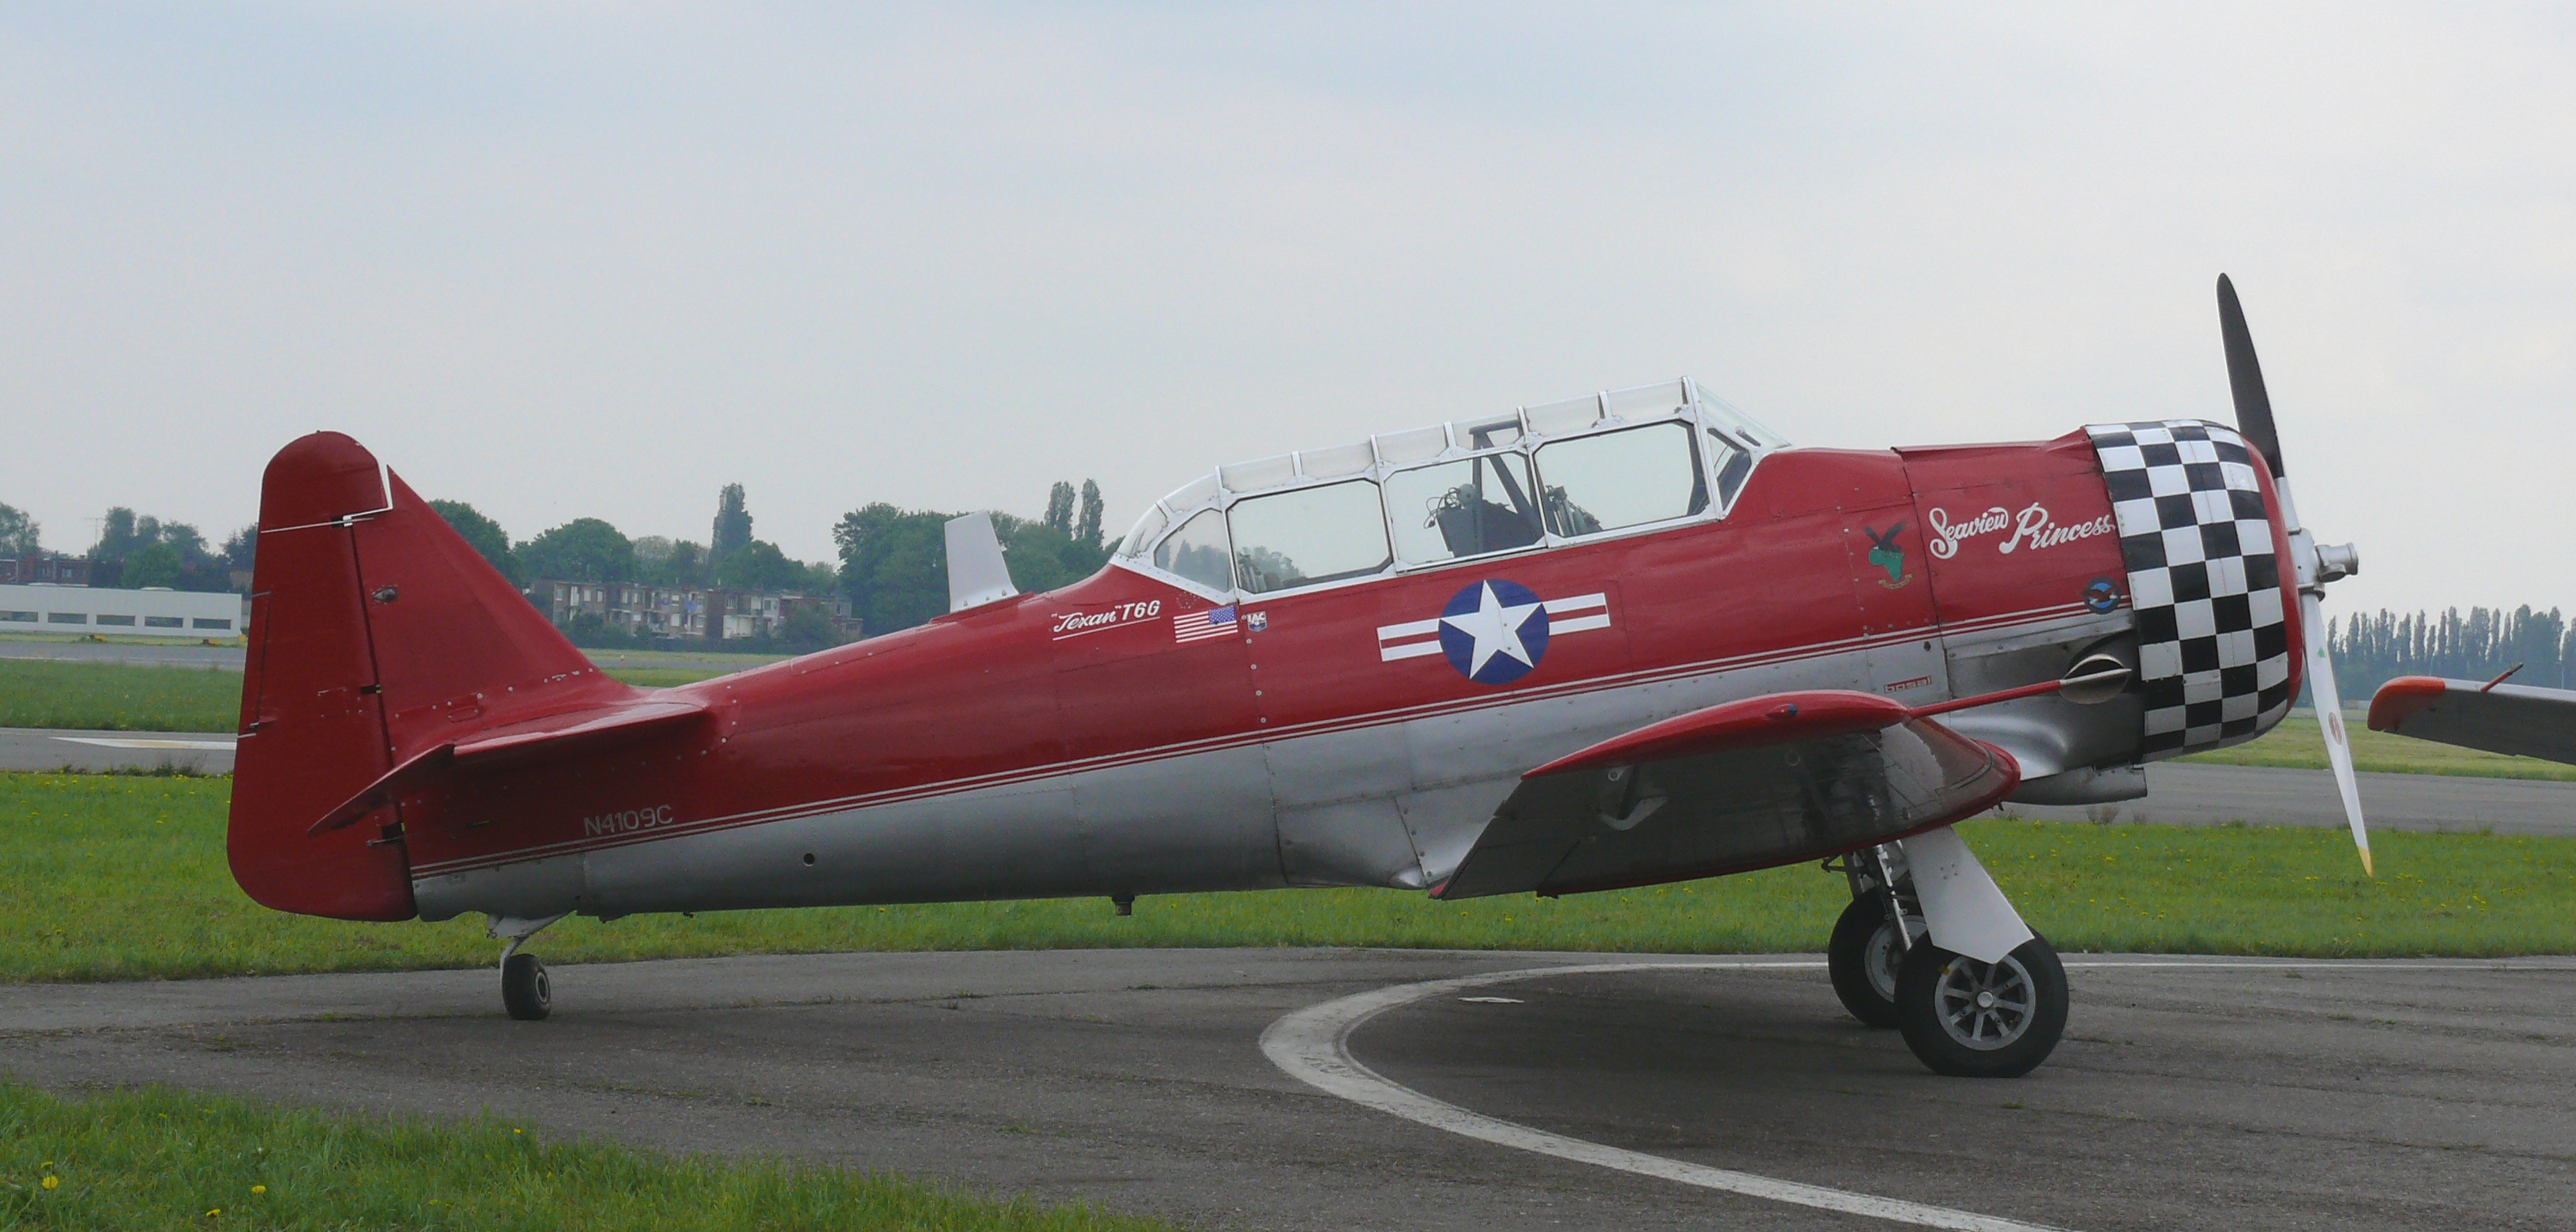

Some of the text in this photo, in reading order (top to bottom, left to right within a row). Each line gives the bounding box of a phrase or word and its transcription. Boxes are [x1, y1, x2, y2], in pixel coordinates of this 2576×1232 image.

[1928, 502, 2116, 559] Seaview Princess
[1120, 600, 1162, 621] T6G
[583, 804, 673, 836] N4109C
